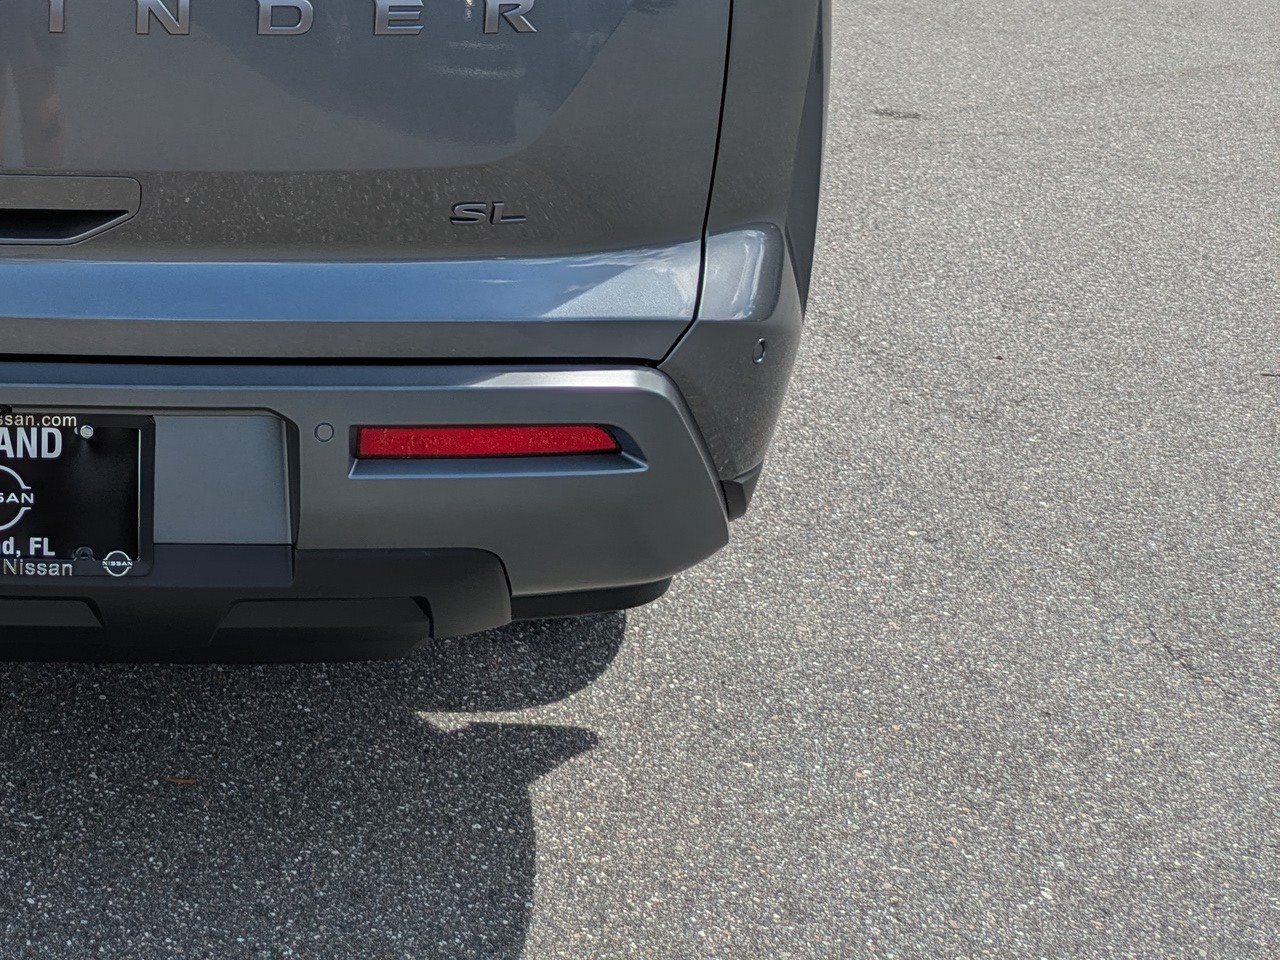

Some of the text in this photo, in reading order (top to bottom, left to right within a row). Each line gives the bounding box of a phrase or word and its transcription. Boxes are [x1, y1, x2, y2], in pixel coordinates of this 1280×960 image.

[449, 202, 527, 225] SL
[29, 537, 55, 556] FL
[2, 558, 74, 577] Nissan
